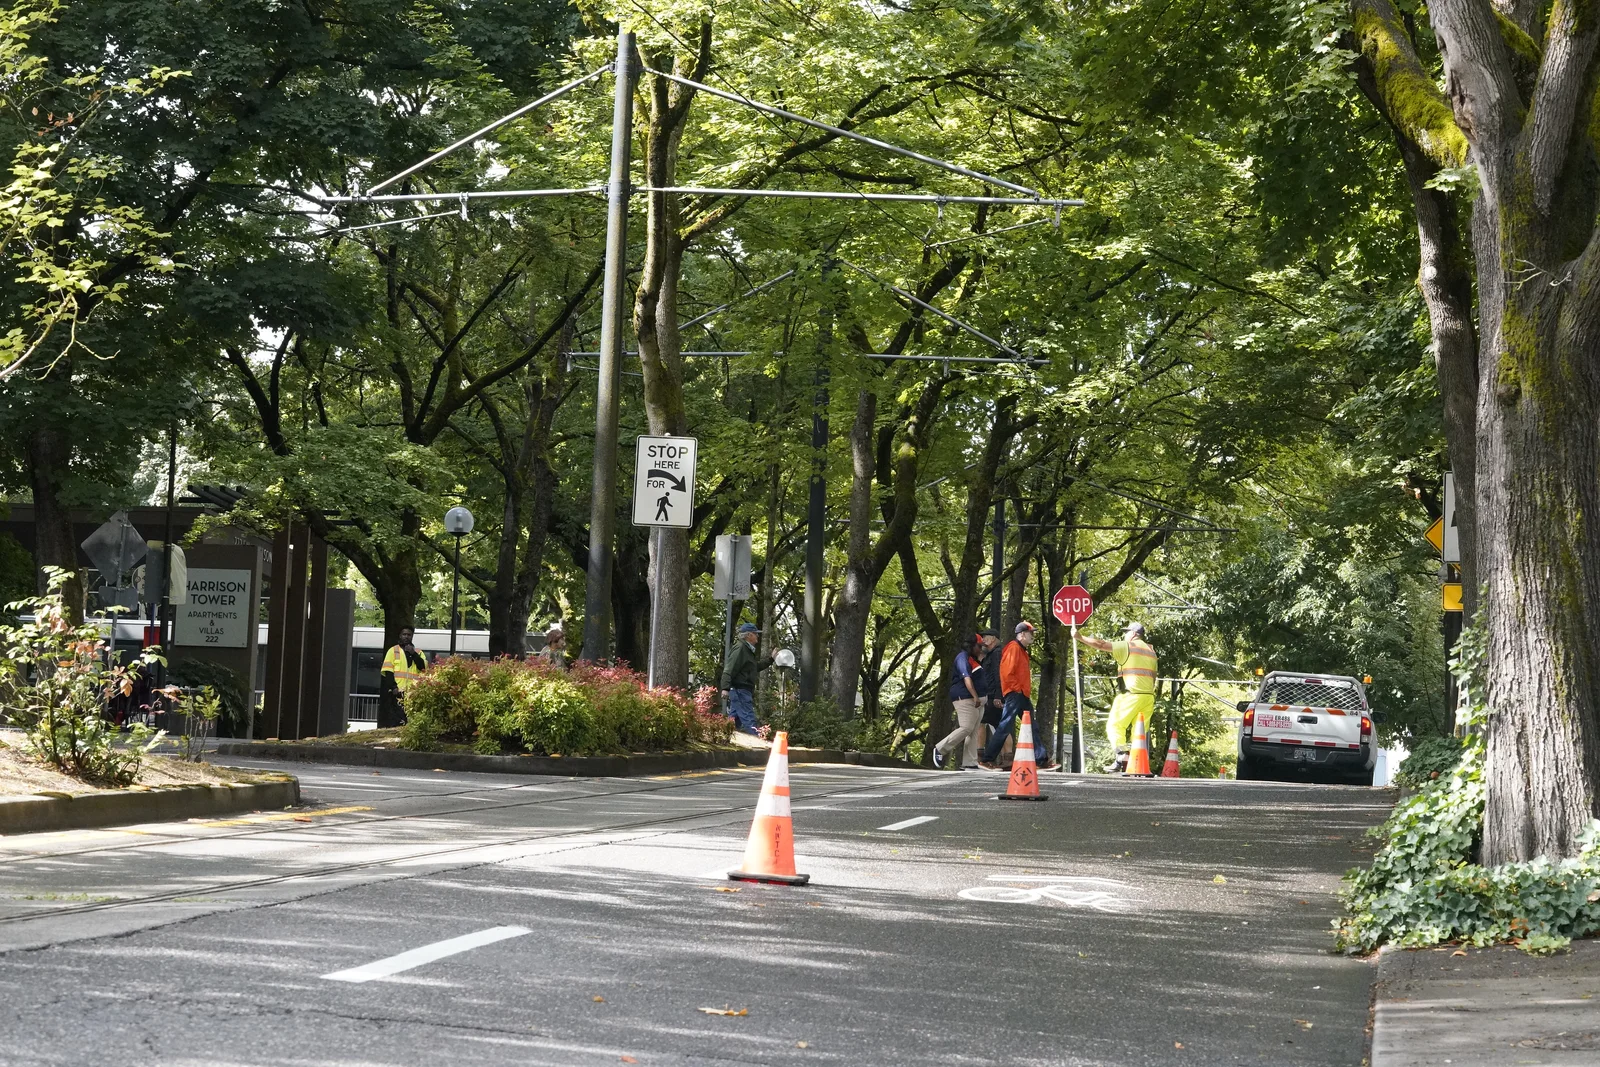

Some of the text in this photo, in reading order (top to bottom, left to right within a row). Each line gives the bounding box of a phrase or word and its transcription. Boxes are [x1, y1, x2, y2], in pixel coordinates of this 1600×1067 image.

[647, 445, 689, 459] STOP
[654, 461, 680, 470] HERE
[646, 480, 665, 489] FOR
[191, 594, 236, 606] TOWER
[1055, 597, 1091, 613] STOP
[187, 611, 237, 619] APARTMENTS
[199, 627, 225, 635] VILLAS
